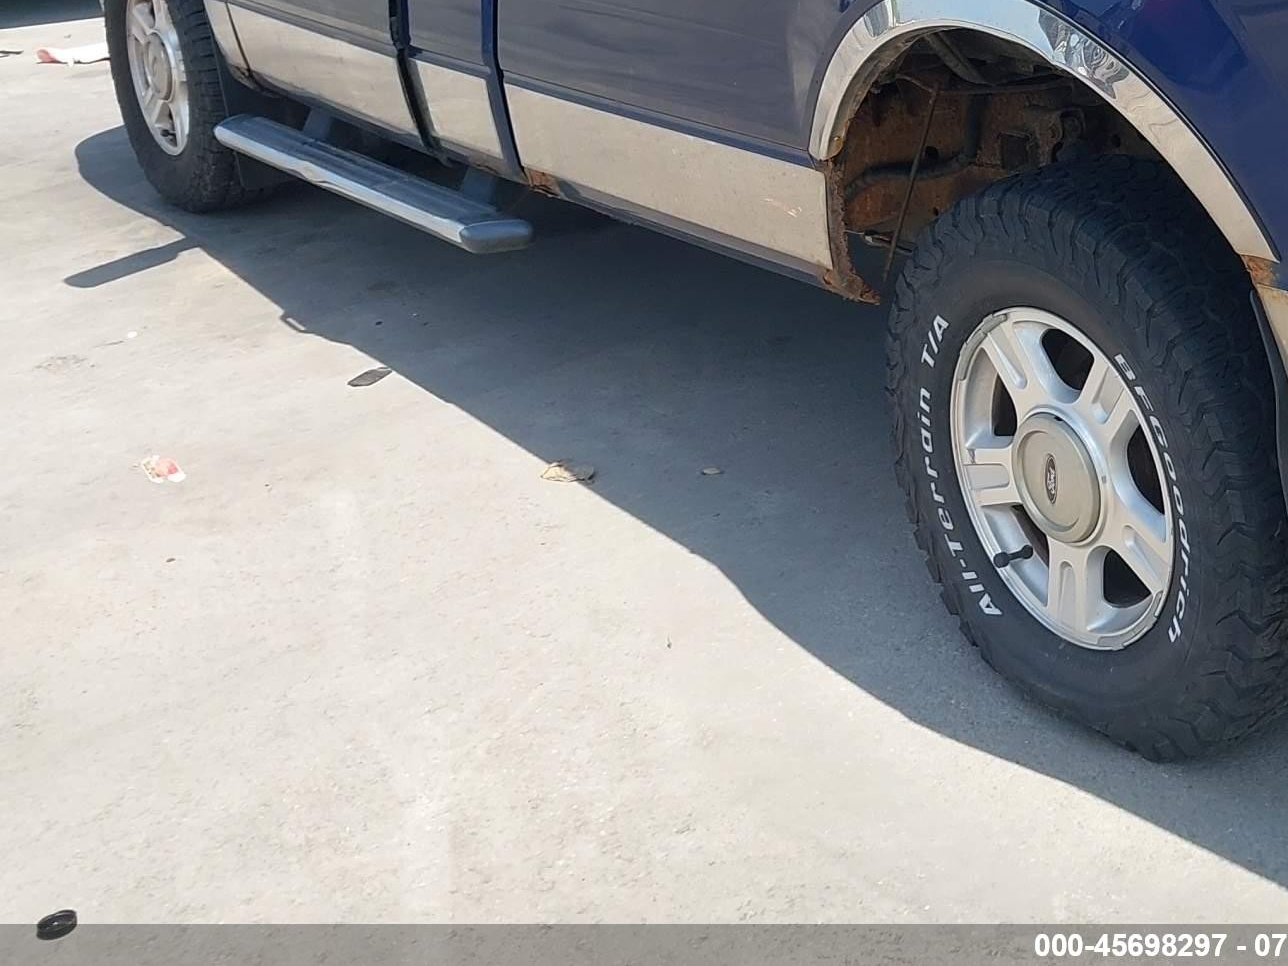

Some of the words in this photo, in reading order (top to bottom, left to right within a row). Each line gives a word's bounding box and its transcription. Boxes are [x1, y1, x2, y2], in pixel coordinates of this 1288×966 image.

[920, 314, 950, 369] T/A
[916, 386, 1003, 617] All-Terrain
[1113, 353, 1192, 643] BFGoodrich
